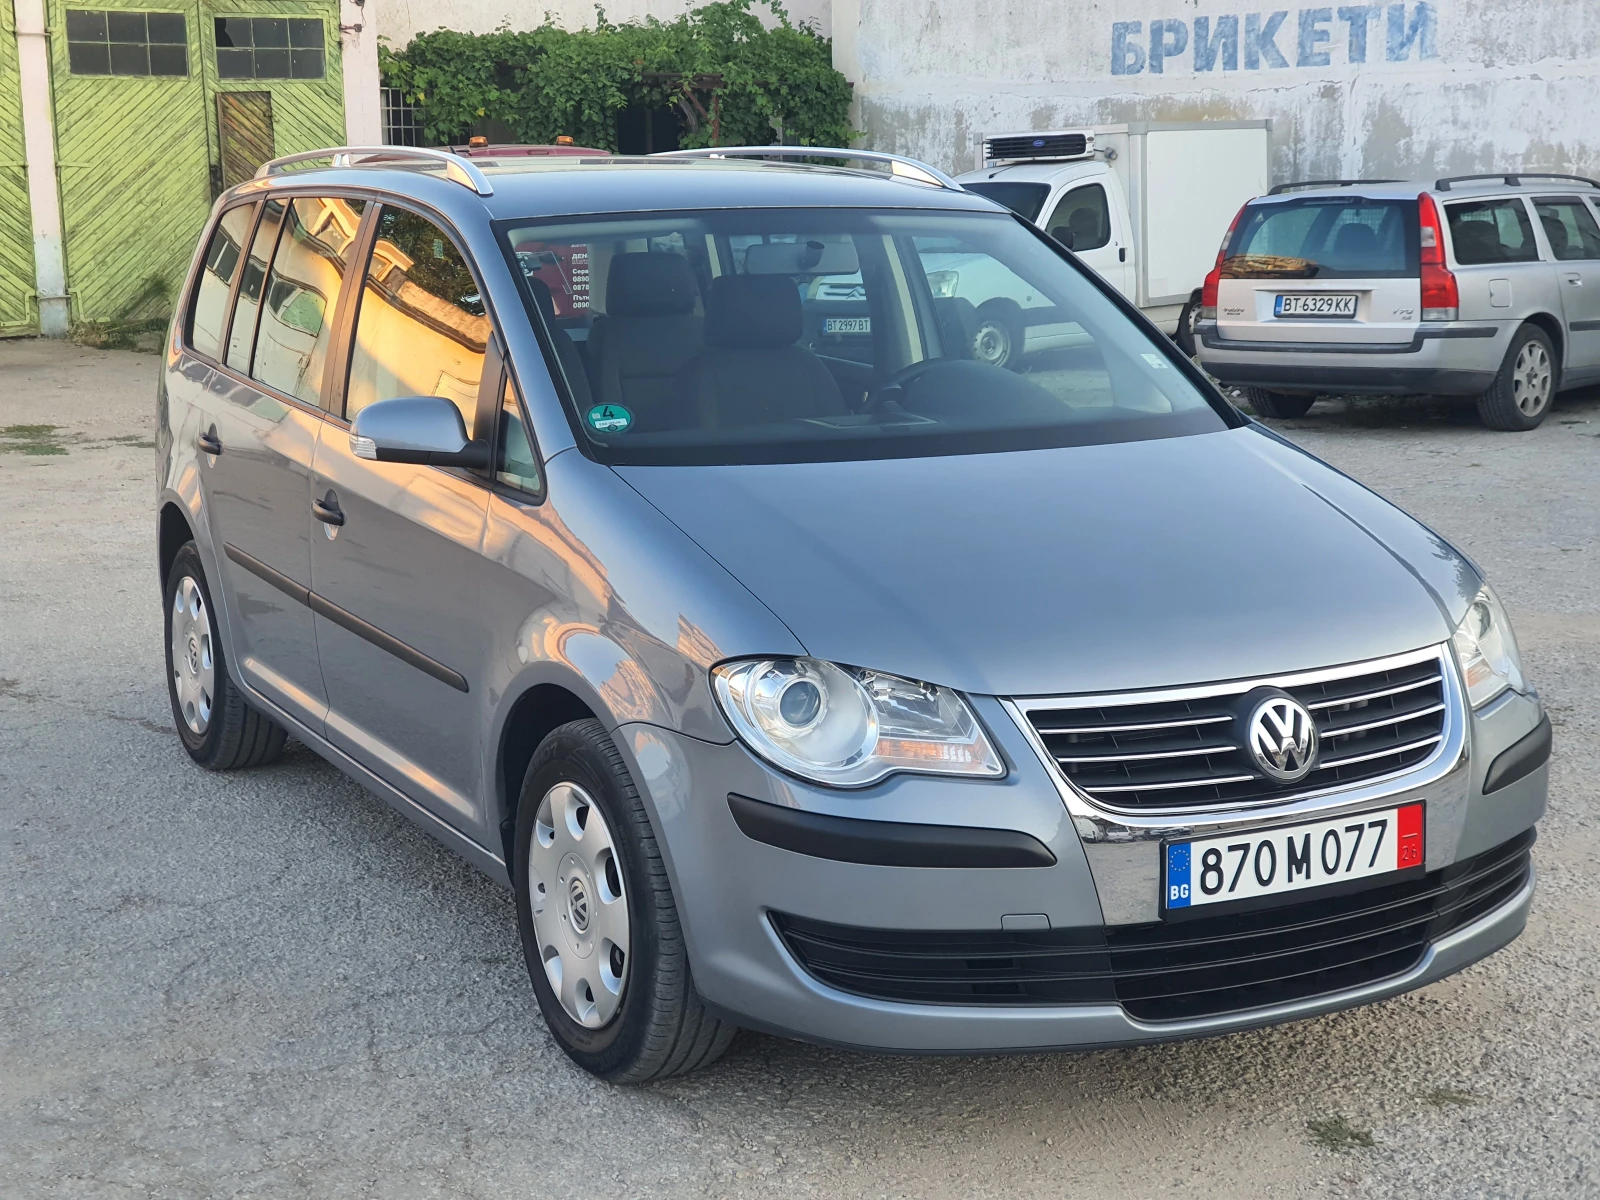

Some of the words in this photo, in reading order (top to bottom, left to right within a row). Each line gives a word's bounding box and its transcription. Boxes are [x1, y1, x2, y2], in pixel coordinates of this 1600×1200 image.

[1111, 1, 1438, 75] БРИКЕТИ
[1283, 298, 1301, 312] BT
[1302, 298, 1334, 312] 6329
[1335, 298, 1353, 312] KK
[827, 320, 837, 331] BT
[838, 320, 858, 331] 2997
[858, 319, 869, 331] BT
[603, 405, 615, 418] 4
[1170, 883, 1189, 901] BG
[1200, 839, 1277, 896] 870
[1287, 832, 1312, 884] M
[1321, 818, 1388, 876] 077
